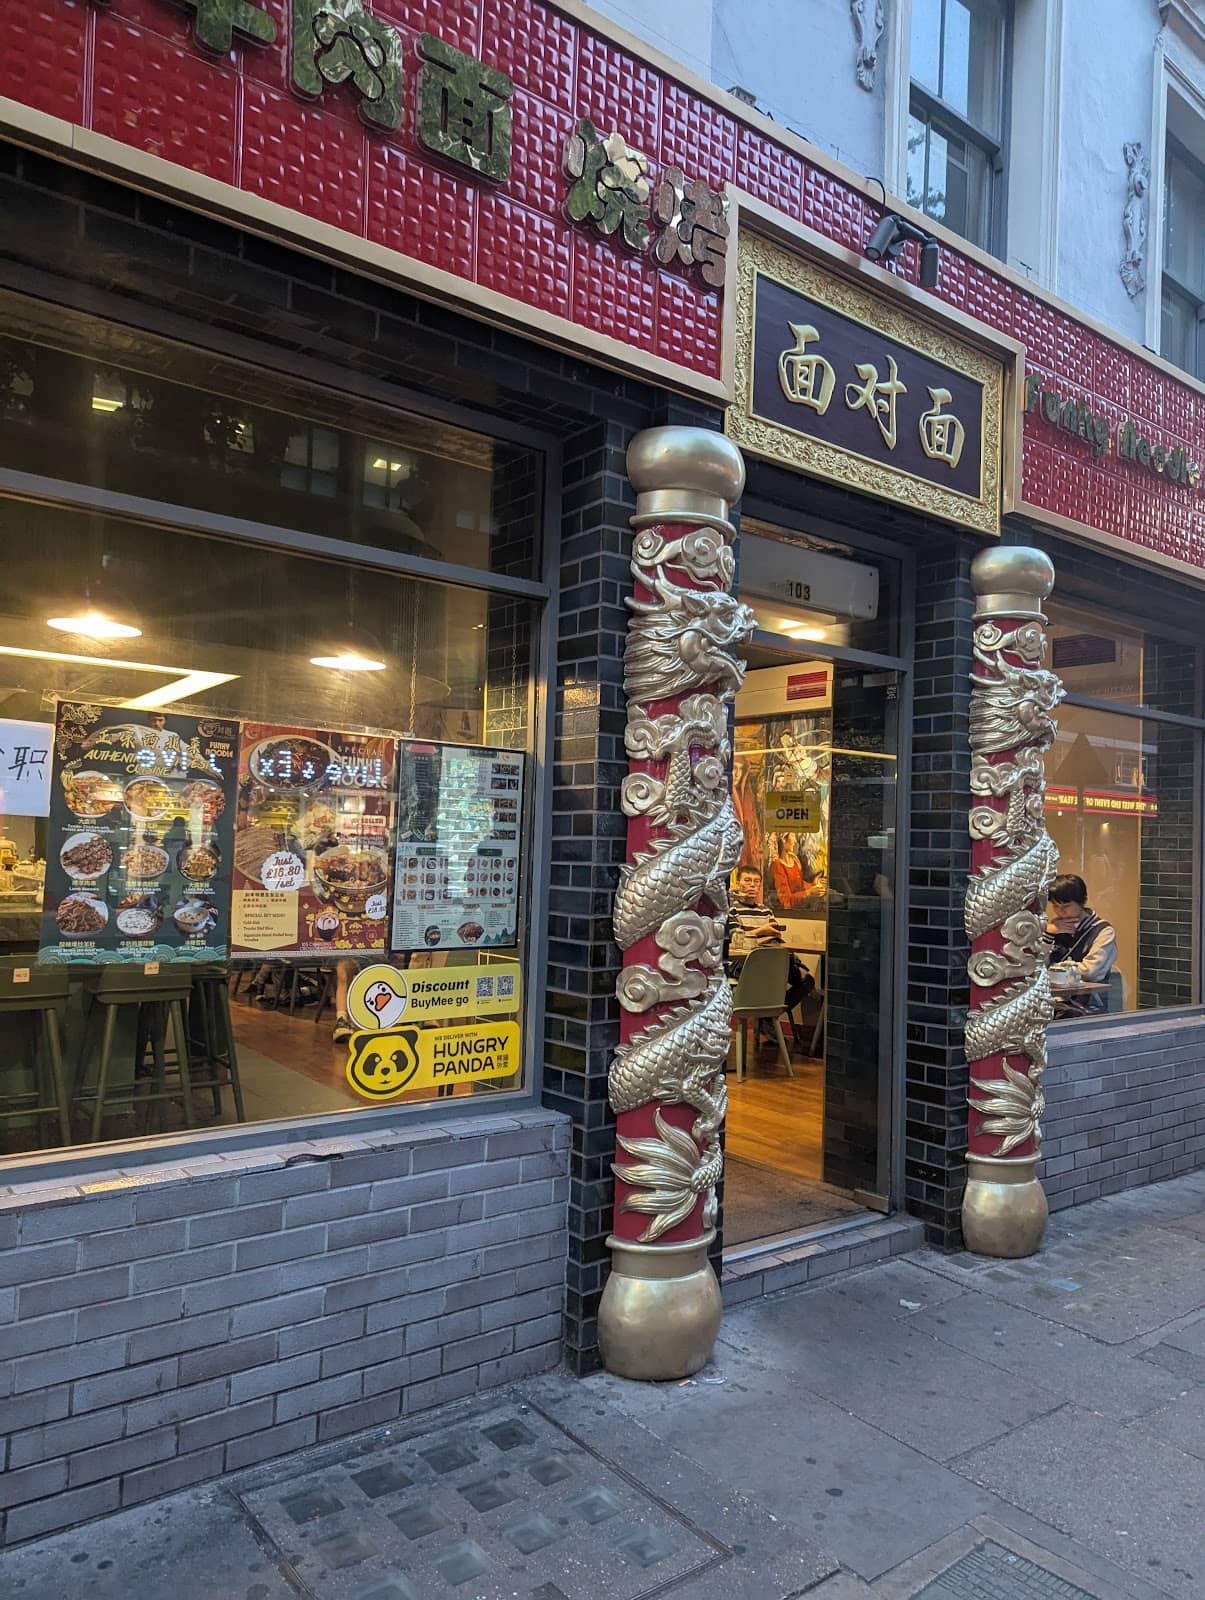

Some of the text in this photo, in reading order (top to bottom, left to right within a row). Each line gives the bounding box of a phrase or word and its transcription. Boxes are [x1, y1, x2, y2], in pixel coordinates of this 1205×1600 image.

[562, 118, 731, 288] 烧烤
[777, 320, 966, 470] 面对面
[789, 582, 811, 600] 103
[0, 746, 48, 781] 职
[84, 749, 143, 766] AUTHENTI
[776, 808, 809, 820] OPEN
[272, 856, 294, 866] Just
[265, 865, 300, 879] £16.80
[412, 980, 470, 993] Discount
[411, 996, 454, 1009] BuyMee
[456, 996, 469, 1006] go
[433, 1035, 509, 1059] HUNGRY
[433, 1055, 495, 1078] PANDA
